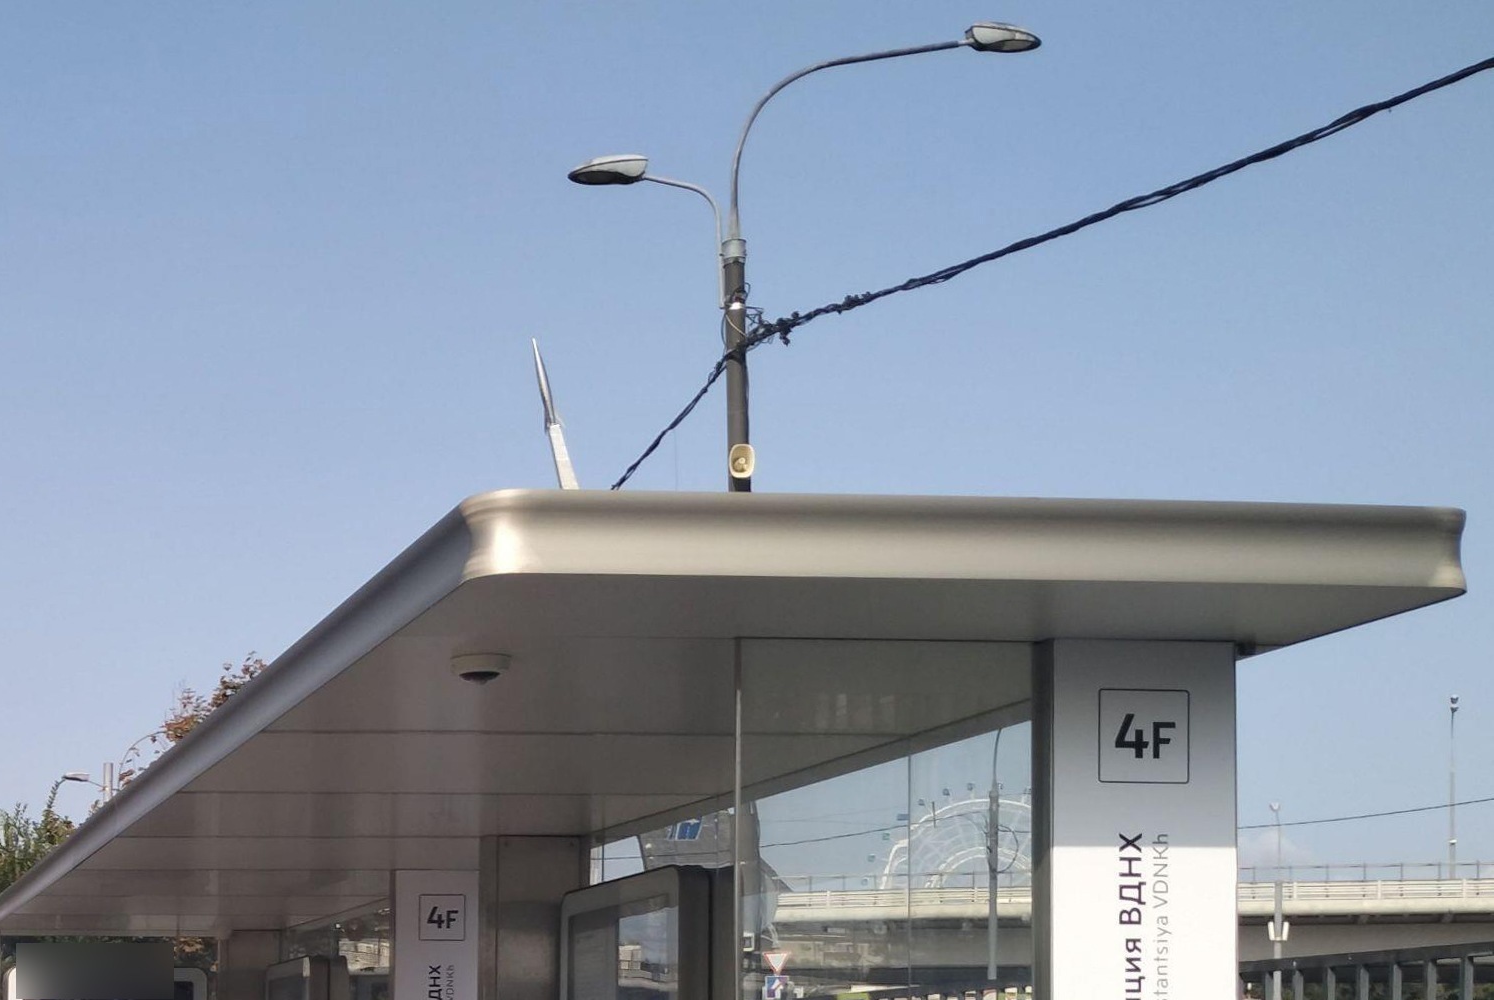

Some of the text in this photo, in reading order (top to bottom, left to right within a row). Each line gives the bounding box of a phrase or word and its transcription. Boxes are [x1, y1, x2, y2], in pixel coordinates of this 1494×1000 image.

[1115, 713, 1176, 759] 4F
[1119, 832, 1146, 925] ВДНХ
[1152, 833, 1169, 908] VDNKh
[427, 906, 459, 929] 4F
